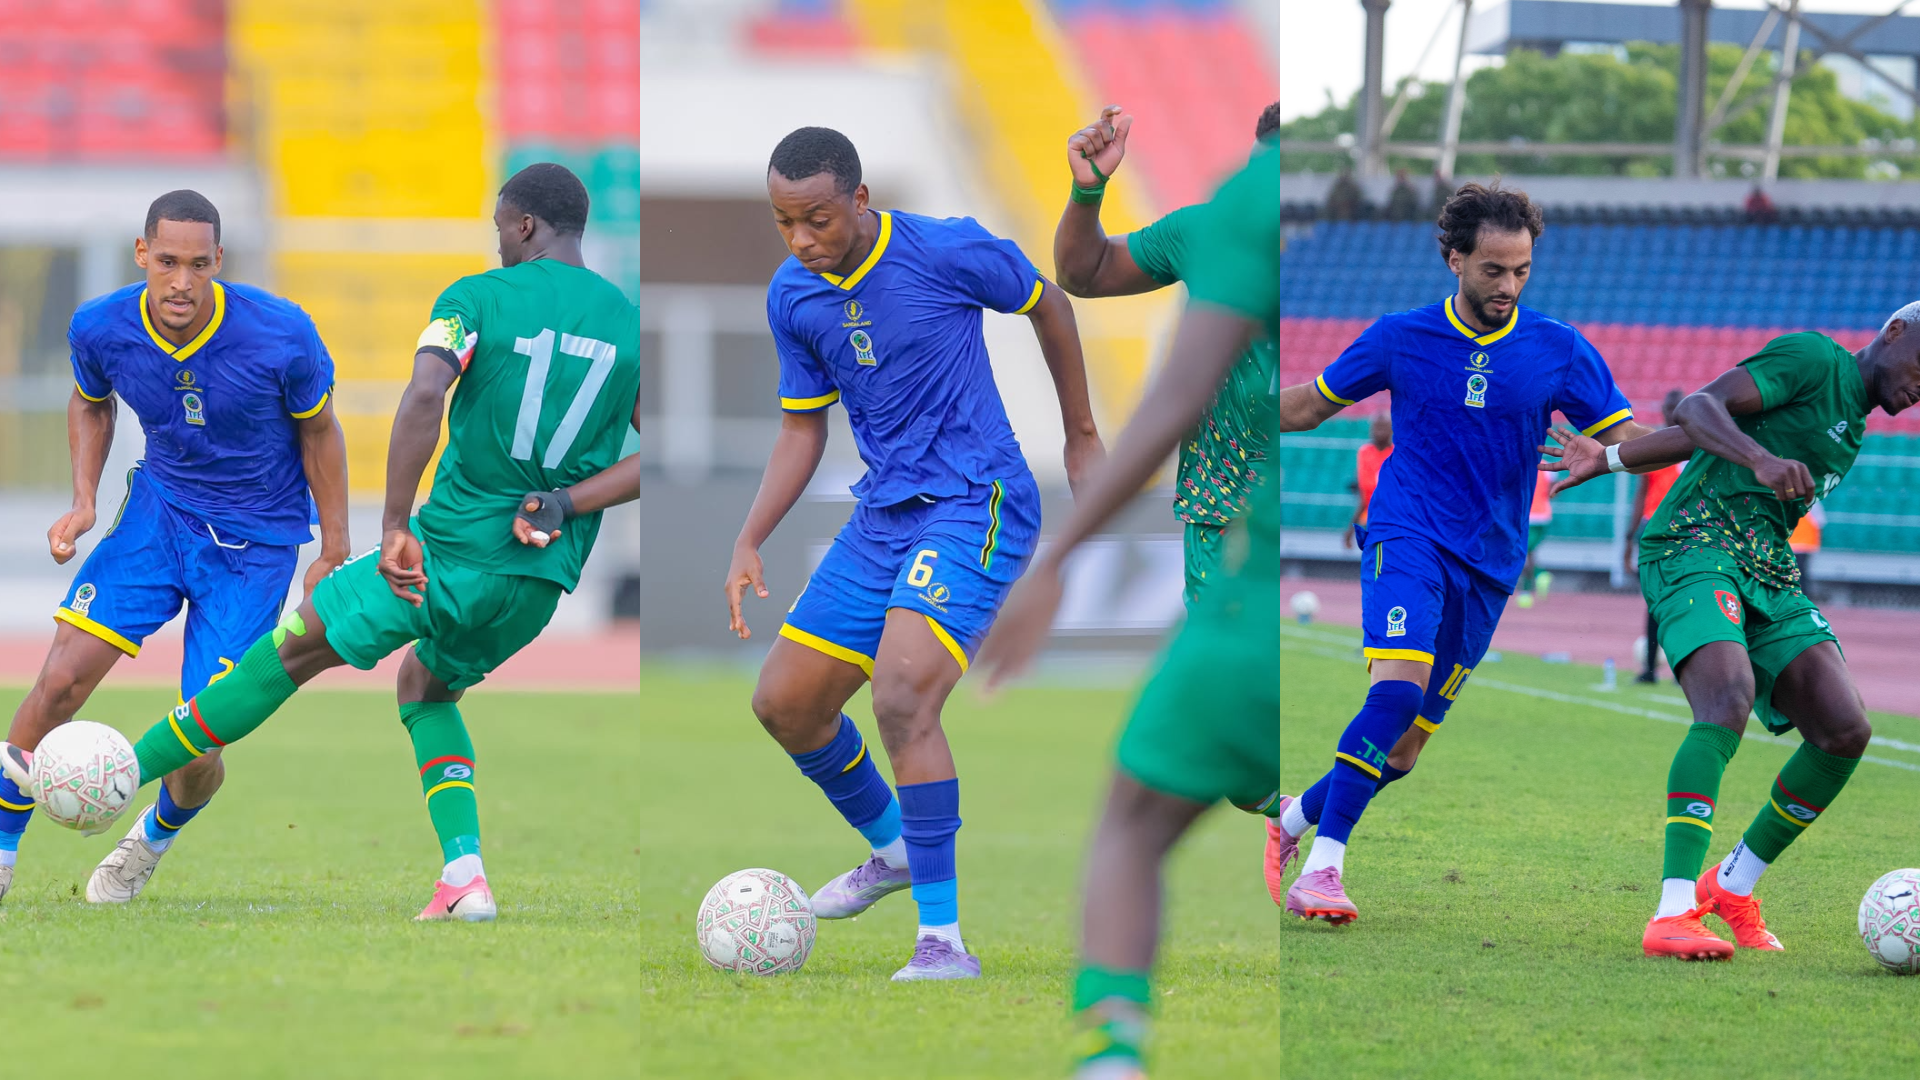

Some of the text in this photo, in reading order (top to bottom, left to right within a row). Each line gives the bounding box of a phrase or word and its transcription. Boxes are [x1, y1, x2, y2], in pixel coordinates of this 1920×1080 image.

[510, 327, 617, 470] 17
[906, 549, 938, 588] 6
[1438, 663, 1472, 701] 10
